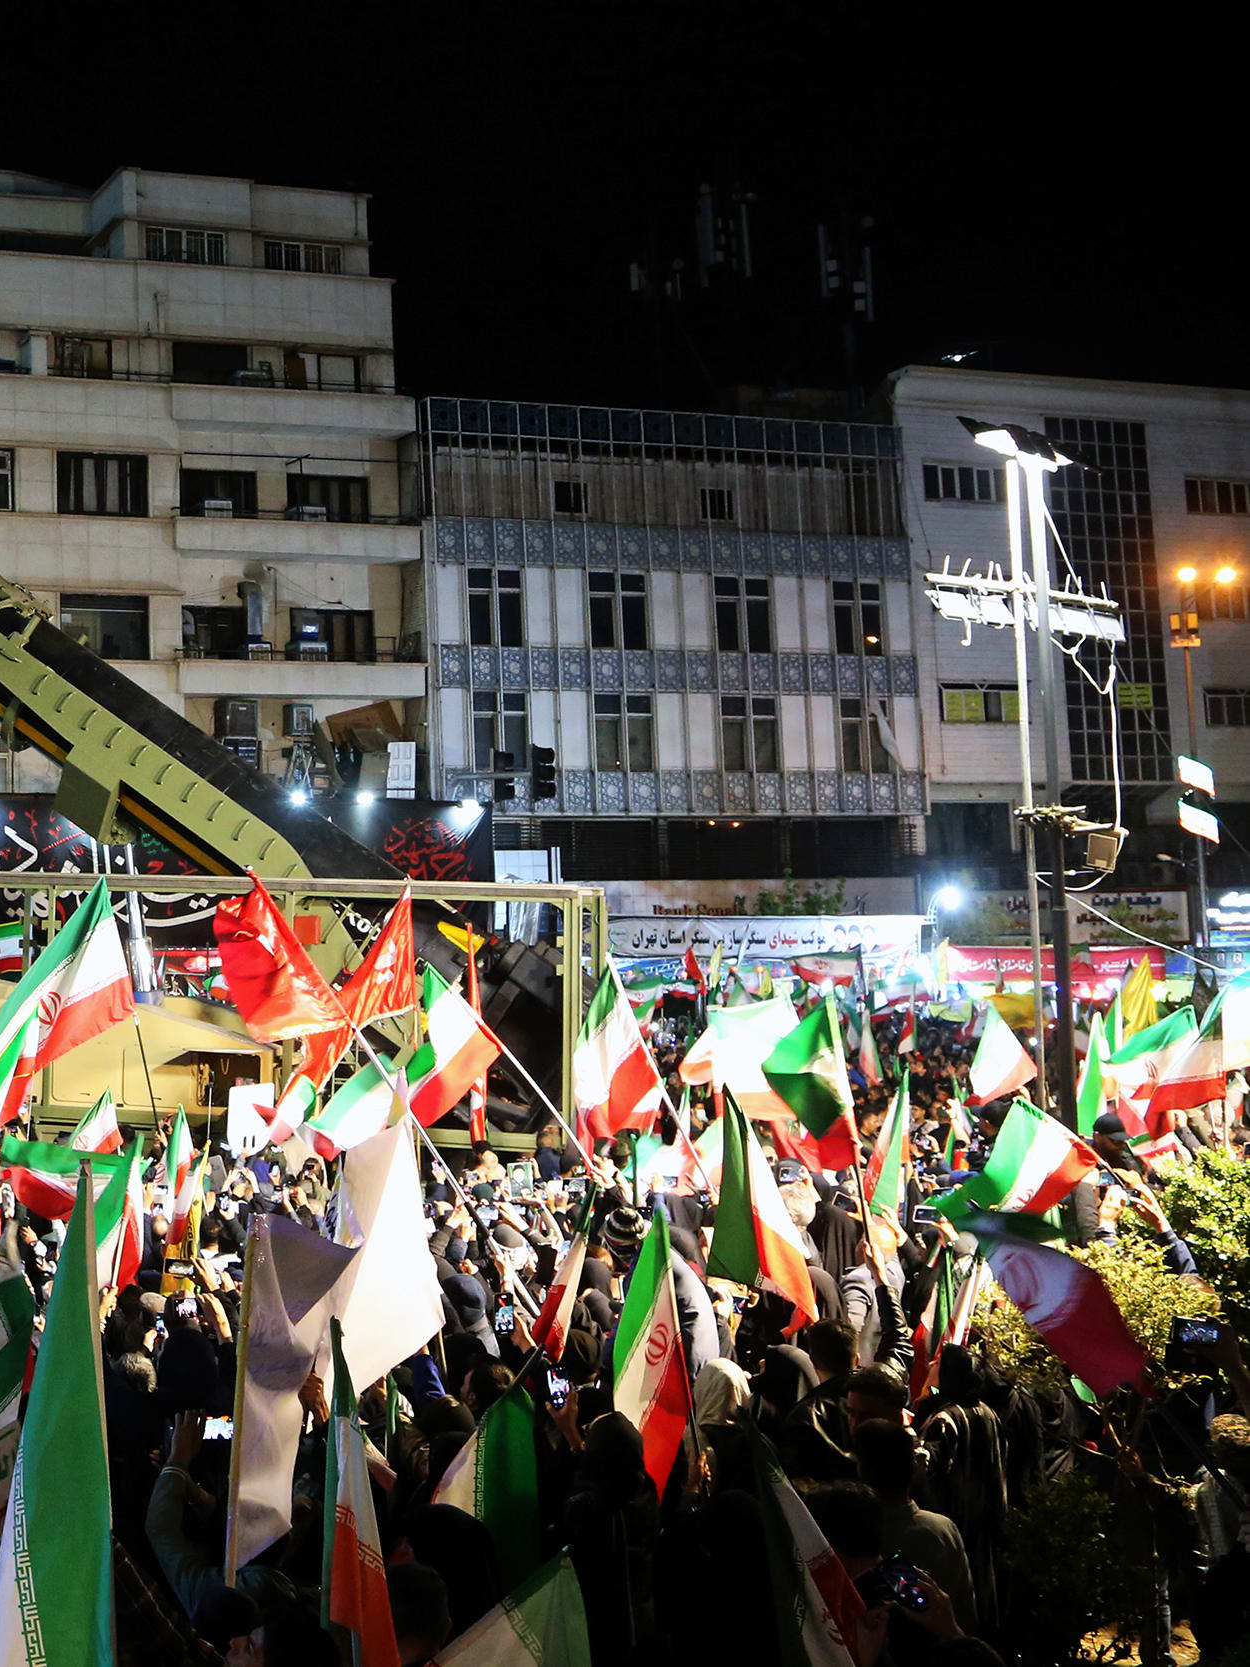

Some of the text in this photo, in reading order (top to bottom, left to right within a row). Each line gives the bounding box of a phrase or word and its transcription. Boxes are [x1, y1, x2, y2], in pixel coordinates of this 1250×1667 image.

[632, 928, 658, 949] تهران
[660, 929, 686, 948] استان
[769, 929, 799, 950] شهدای
